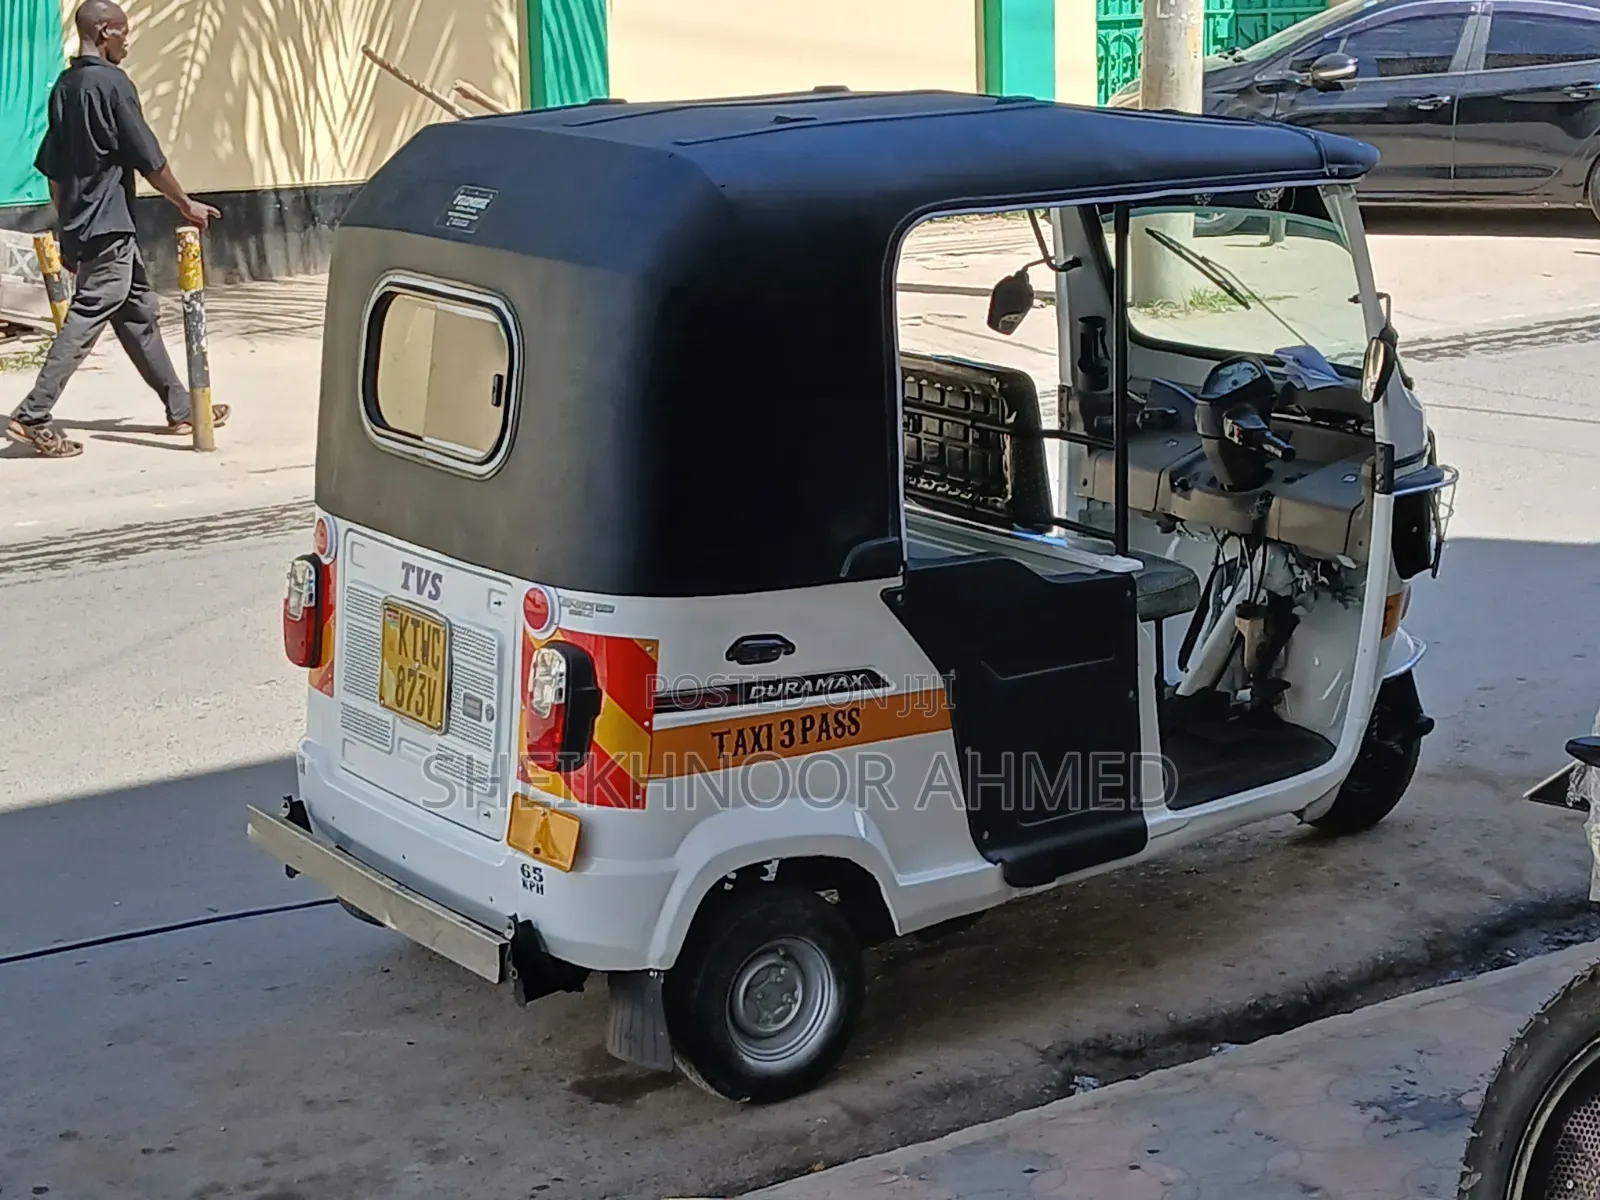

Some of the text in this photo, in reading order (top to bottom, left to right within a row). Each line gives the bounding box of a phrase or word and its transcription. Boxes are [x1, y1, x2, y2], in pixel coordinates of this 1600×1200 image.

[401, 561, 443, 601] TVS
[398, 612, 441, 673] KTWC
[395, 664, 437, 722] 873V
[749, 673, 865, 700] DURAMAX
[710, 707, 861, 759] TAXI 3 PASS
[520, 863, 544, 882] 65
[522, 878, 544, 896] KPH
